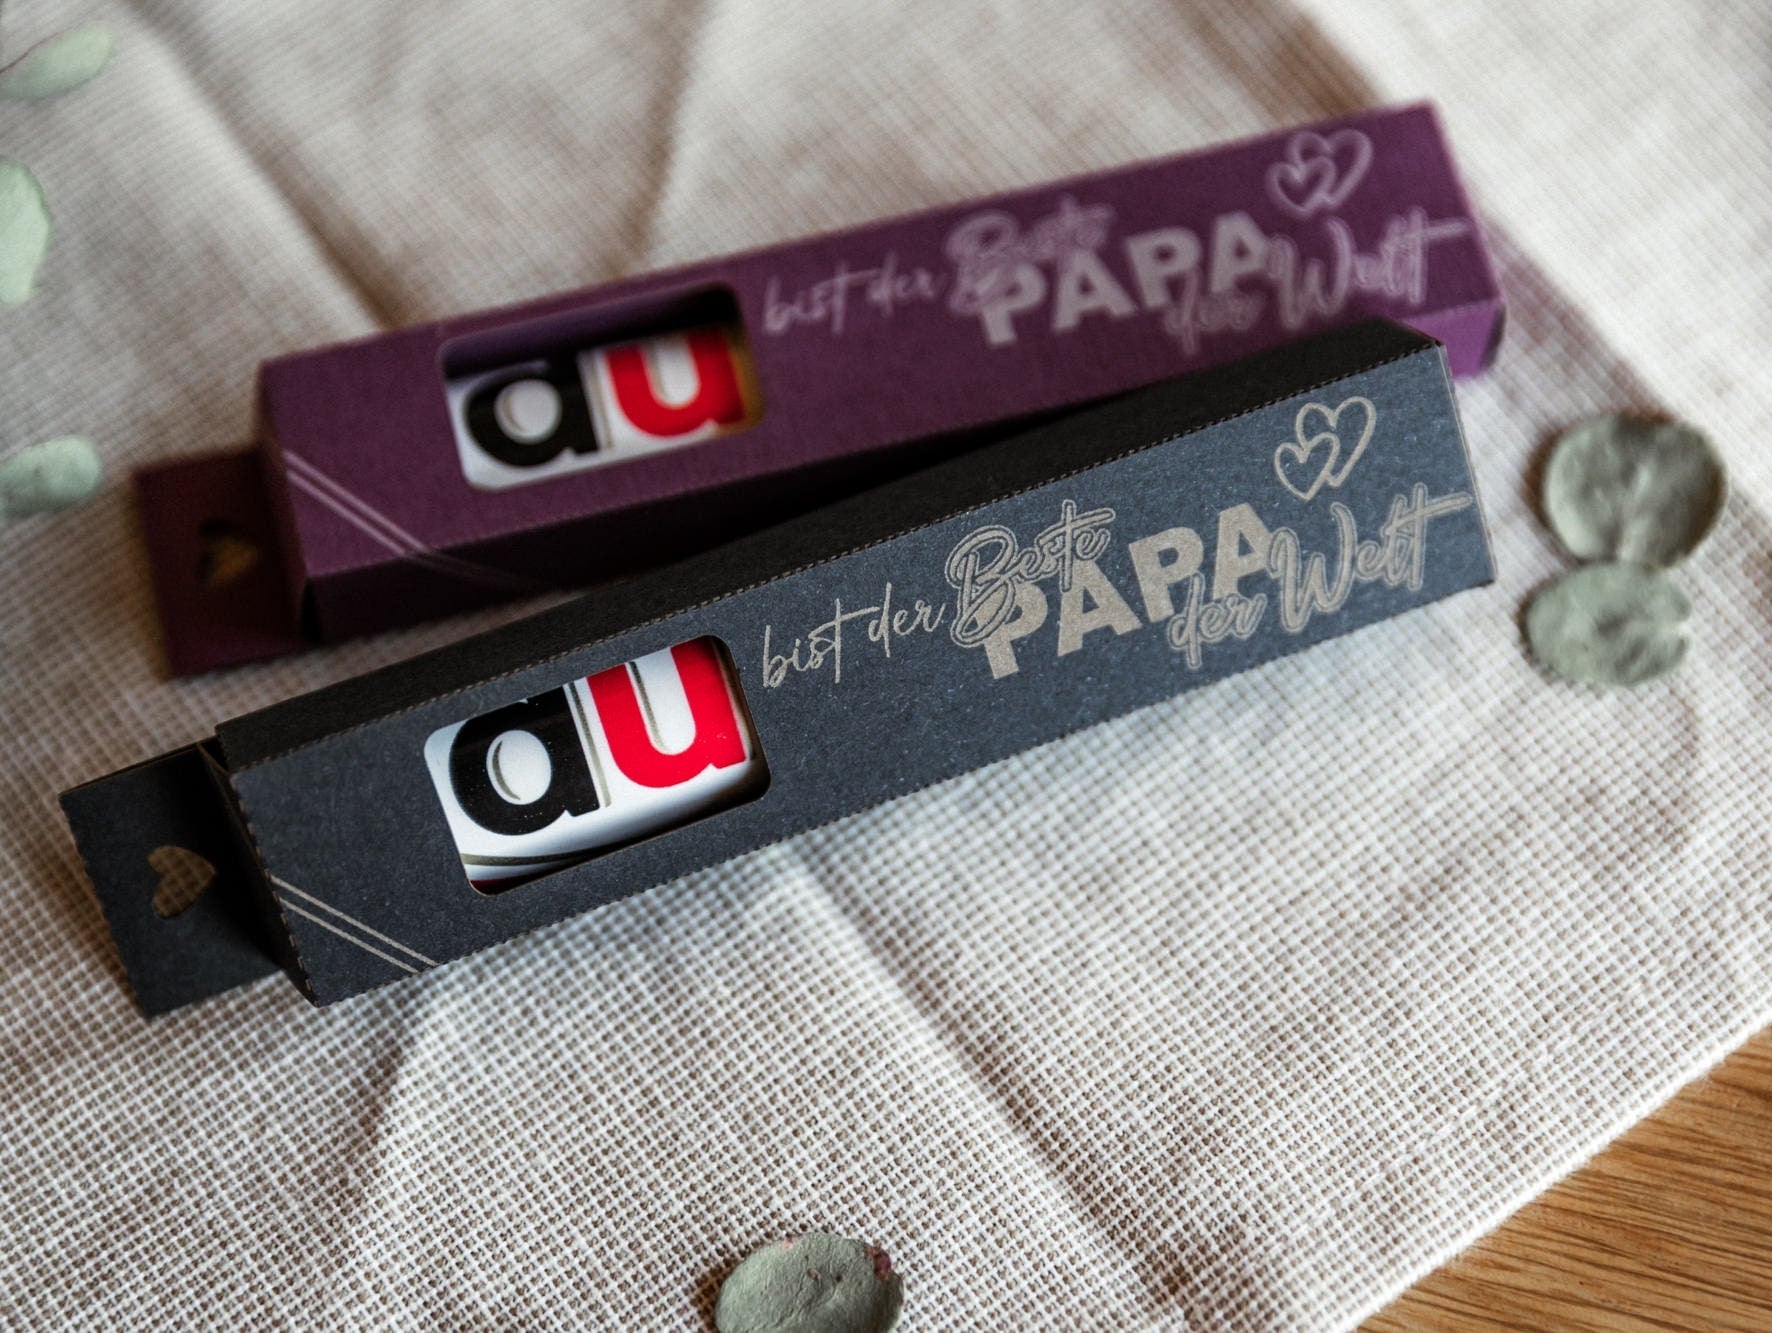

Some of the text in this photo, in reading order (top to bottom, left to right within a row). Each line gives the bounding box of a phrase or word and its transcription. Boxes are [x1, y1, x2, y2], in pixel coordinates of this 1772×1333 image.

[762, 250, 942, 335] bist der
[972, 209, 1272, 347] PAPA
[1160, 203, 1470, 355] der Welt
[761, 582, 945, 688] bist der
[944, 499, 1115, 648] Beste
[972, 502, 1275, 680] PAPA
[1167, 482, 1473, 669] der Welt
